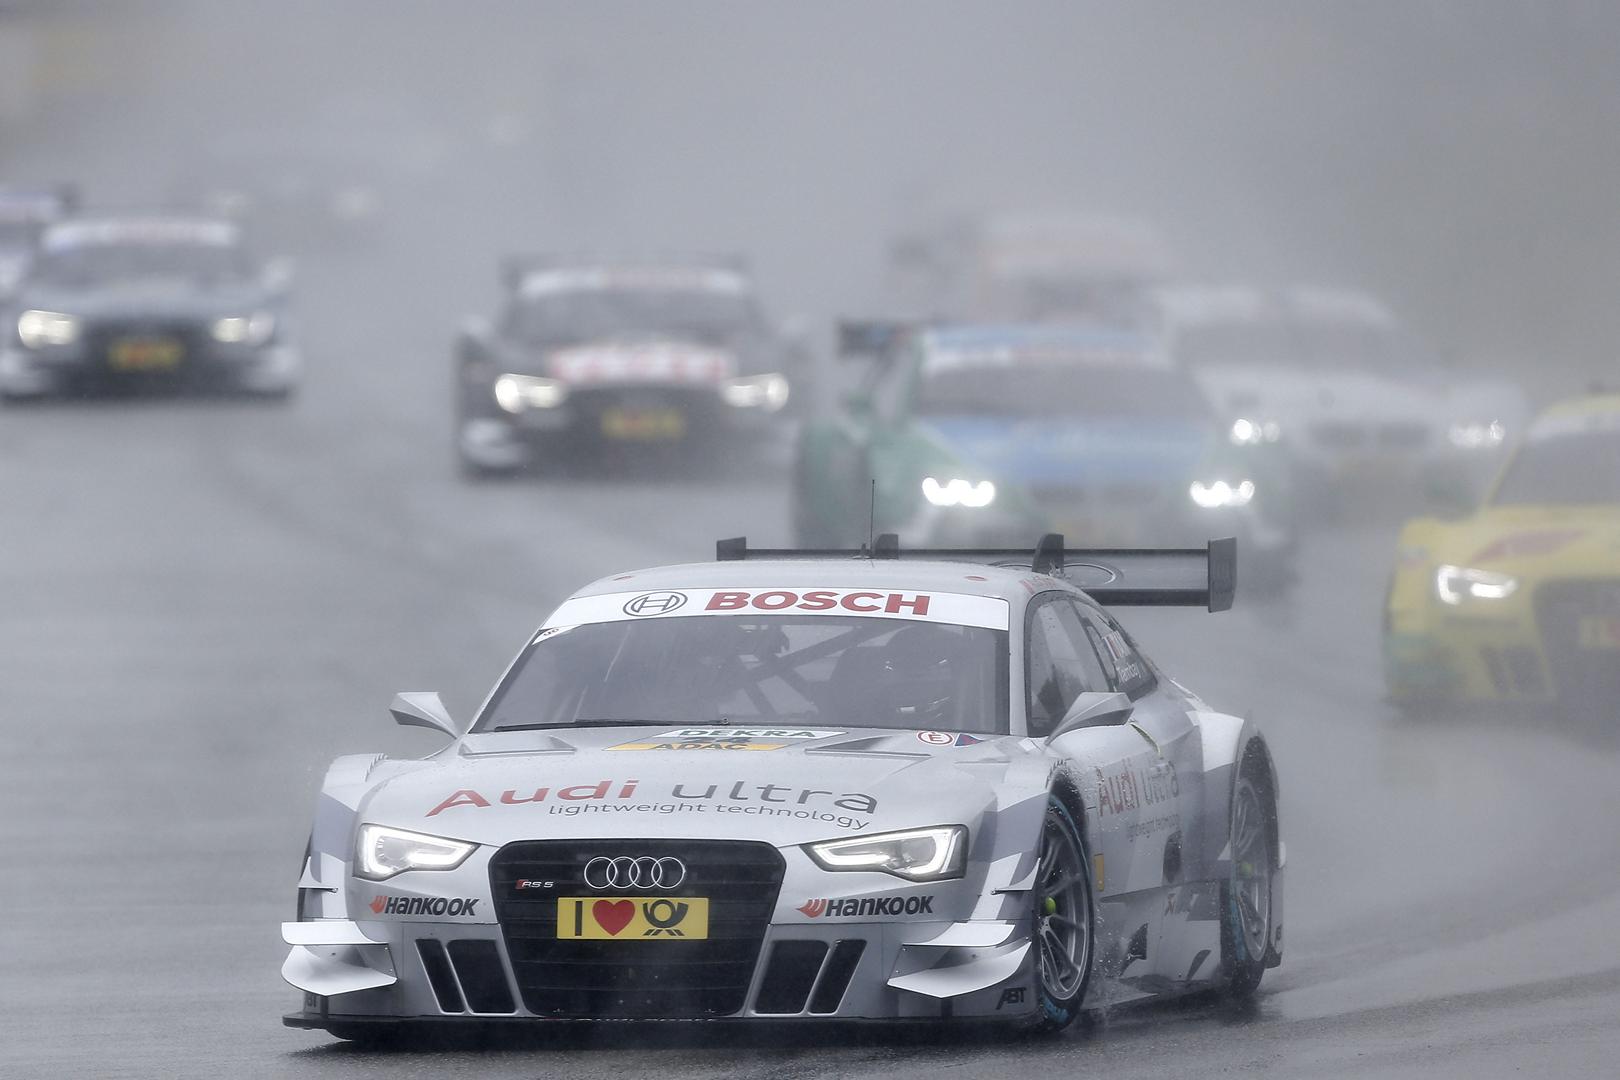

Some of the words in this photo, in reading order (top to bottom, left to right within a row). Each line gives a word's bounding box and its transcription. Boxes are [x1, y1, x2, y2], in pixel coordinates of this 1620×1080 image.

[704, 591, 930, 615] BOSCH
[425, 780, 639, 817] Audi
[672, 780, 878, 814] ultra
[549, 801, 708, 816] lightweight
[716, 803, 870, 831] technology
